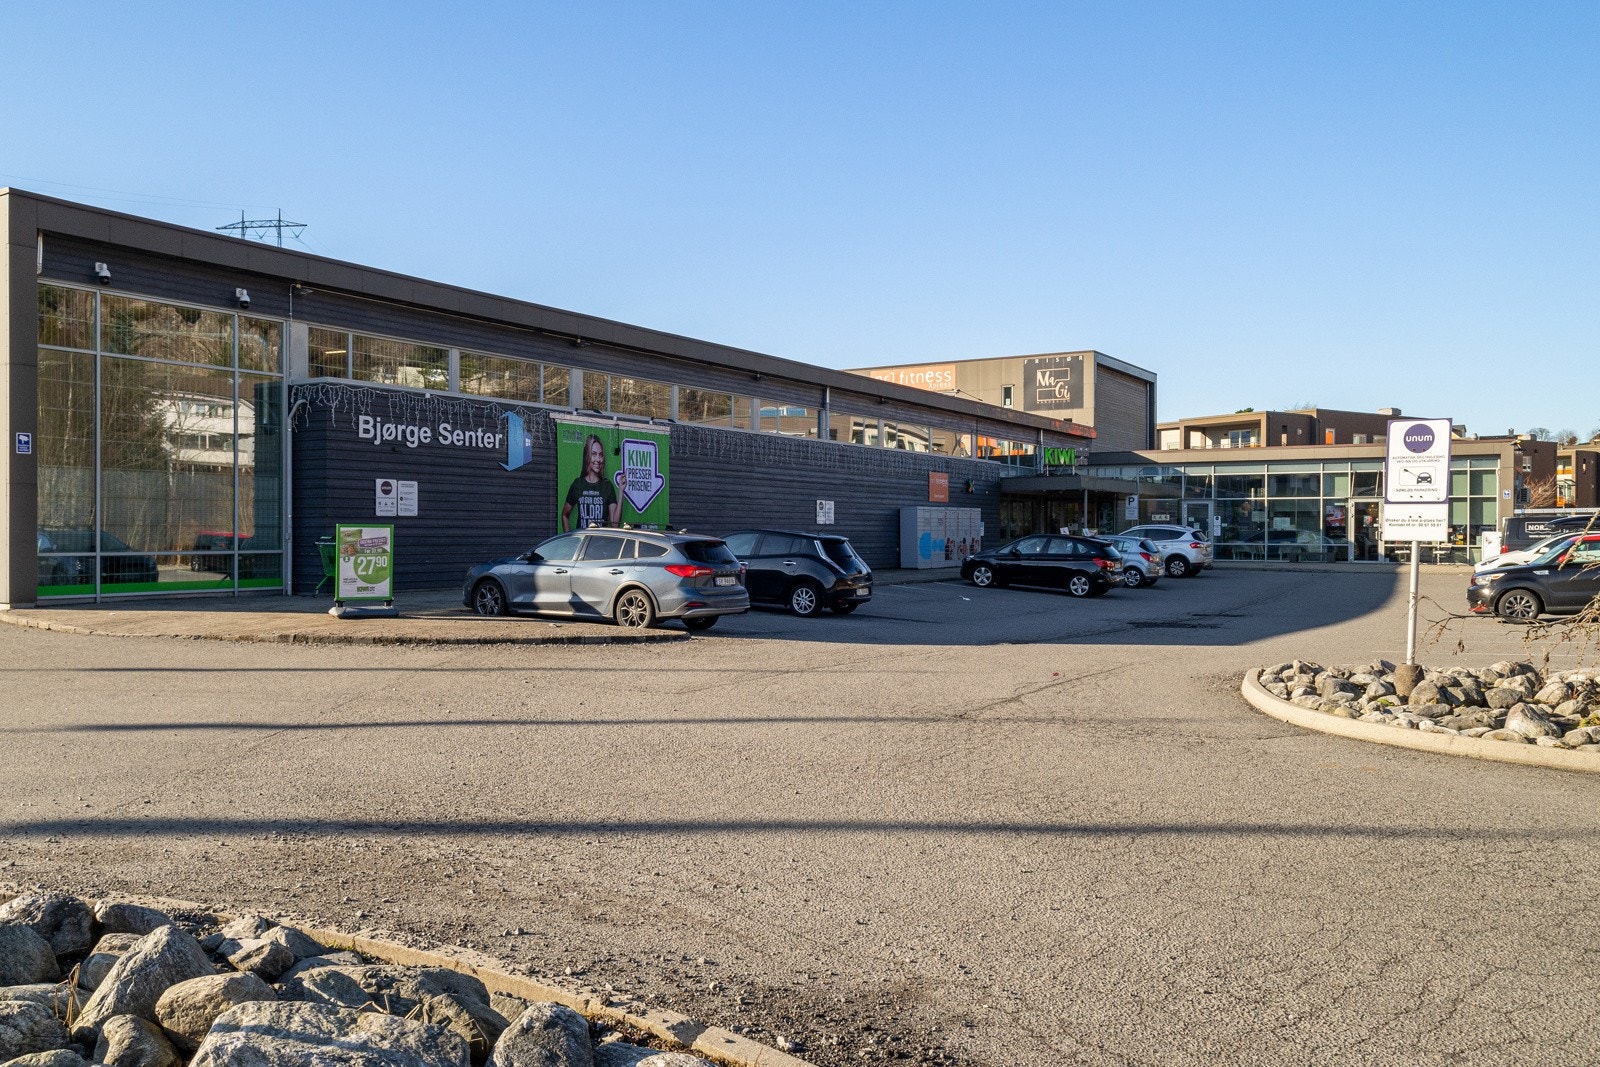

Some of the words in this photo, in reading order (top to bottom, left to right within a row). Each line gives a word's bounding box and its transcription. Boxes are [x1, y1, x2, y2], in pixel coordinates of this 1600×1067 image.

[899, 371, 952, 385] fitness
[358, 415, 432, 448] Bjørge
[438, 423, 503, 449] Senter
[1405, 434, 1433, 442] unum
[628, 450, 652, 468] KIWI
[1044, 447, 1075, 465] KIWI
[628, 467, 652, 480] PRESSER
[628, 479, 653, 492] PRISENE!
[1128, 496, 1135, 506] P
[580, 504, 604, 520] ALDRI
